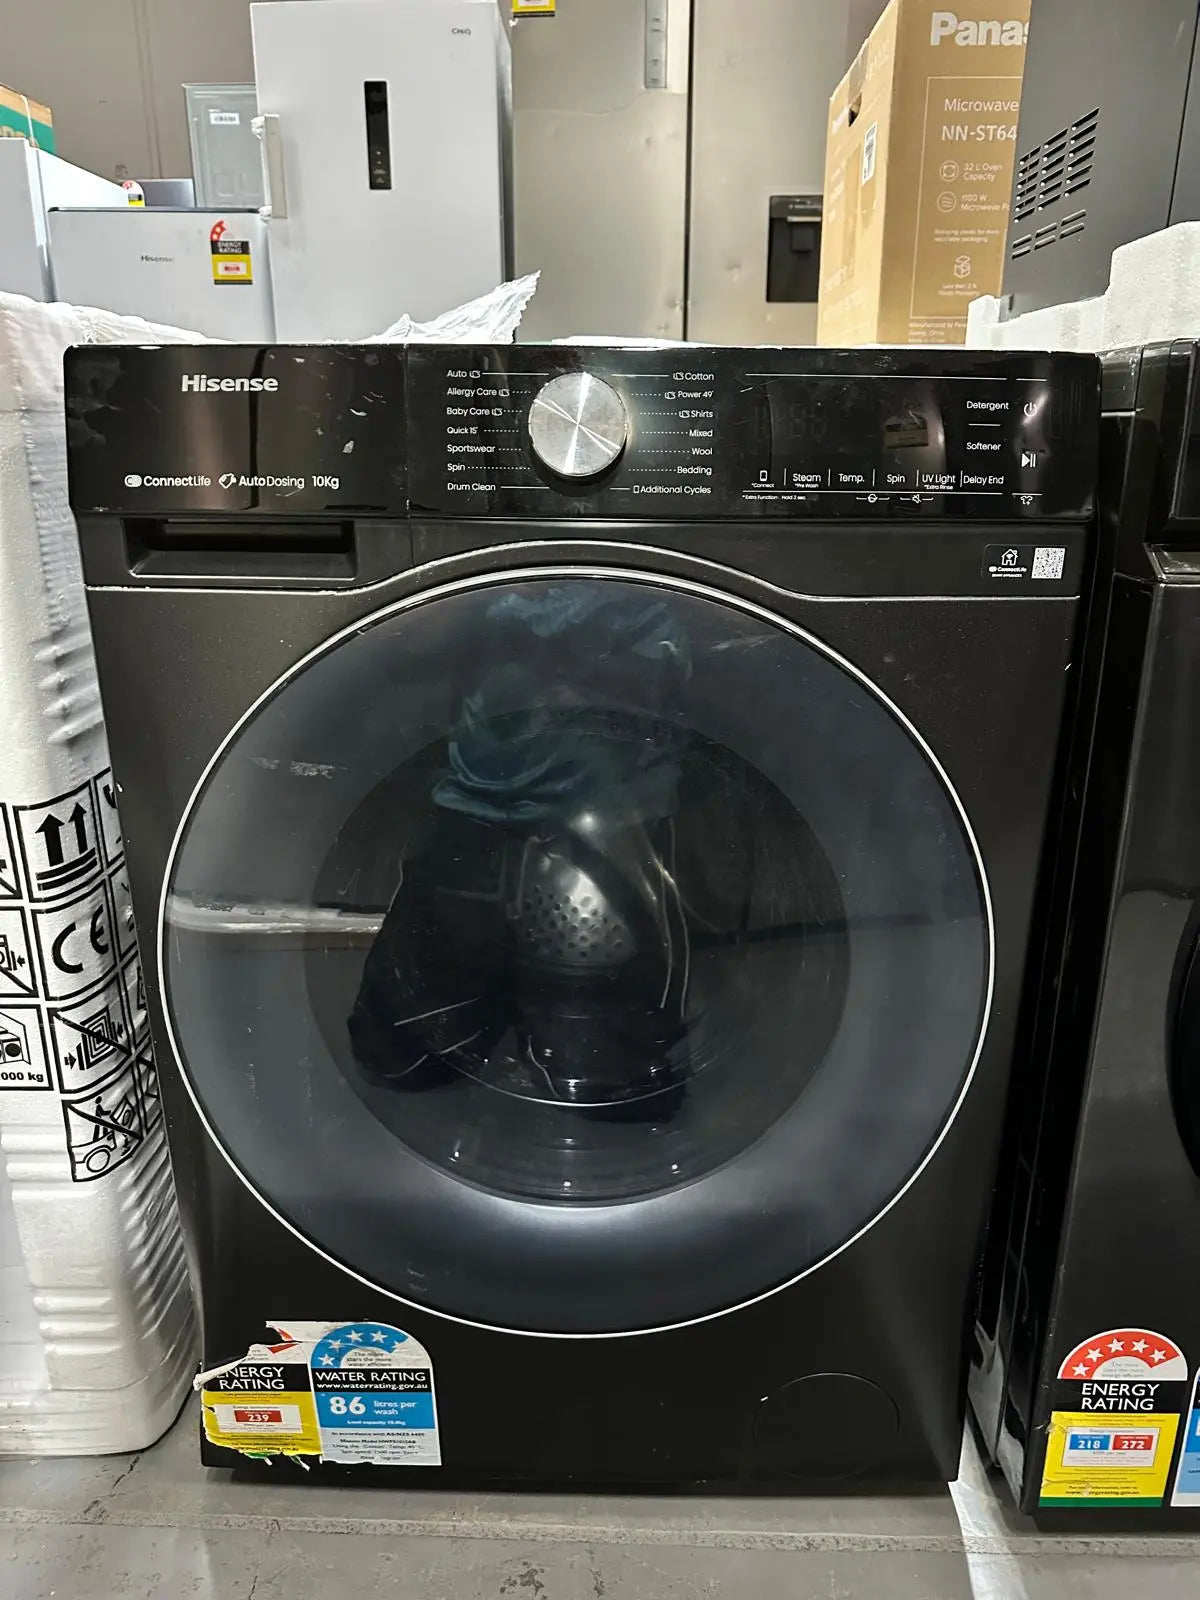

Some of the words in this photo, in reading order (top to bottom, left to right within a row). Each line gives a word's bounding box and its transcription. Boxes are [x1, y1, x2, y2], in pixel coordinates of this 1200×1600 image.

[944, 98, 1019, 112] Microwave
[963, 172, 996, 182] Capacity
[446, 369, 468, 378] Auto
[684, 372, 715, 381] Cotton
[181, 374, 279, 392] Hisense
[446, 387, 475, 397] Allergy
[476, 388, 498, 396] Care
[677, 390, 702, 398] Power
[966, 400, 1010, 411] Detergent
[446, 407, 469, 417] Baby
[469, 407, 490, 416] Care
[690, 409, 714, 418] Shirts
[446, 426, 469, 434] Quick
[689, 429, 713, 437] Mixed
[447, 444, 496, 454] Sportswear
[691, 447, 713, 455] Wool
[966, 442, 1002, 451] Softener
[447, 463, 466, 472] Spin
[677, 466, 712, 476] Bedding
[143, 475, 212, 487] ConnectLife
[311, 475, 340, 490] 10Kg
[792, 473, 821, 482] Steam
[838, 473, 865, 484] Temp.
[886, 474, 906, 484] Spin
[922, 474, 934, 483] UV
[935, 474, 956, 484] Light
[963, 475, 987, 486] Delay
[988, 475, 1004, 484] End
[447, 482, 471, 491] Drum
[471, 482, 496, 491] Clean
[640, 485, 682, 494] Additional
[683, 485, 712, 495] Cycles
[28, 1072, 44, 1082] kg
[315, 1372, 367, 1382] WATER
[370, 1372, 426, 1382] RATING
[219, 1379, 285, 1389] RATING
[1082, 1383, 1160, 1396] ENERGY
[330, 1396, 366, 1415] 86
[1081, 1398, 1155, 1411] RATING
[247, 1414, 269, 1422] 239
[1078, 1440, 1101, 1449] 218
[1121, 1440, 1145, 1449] 272
